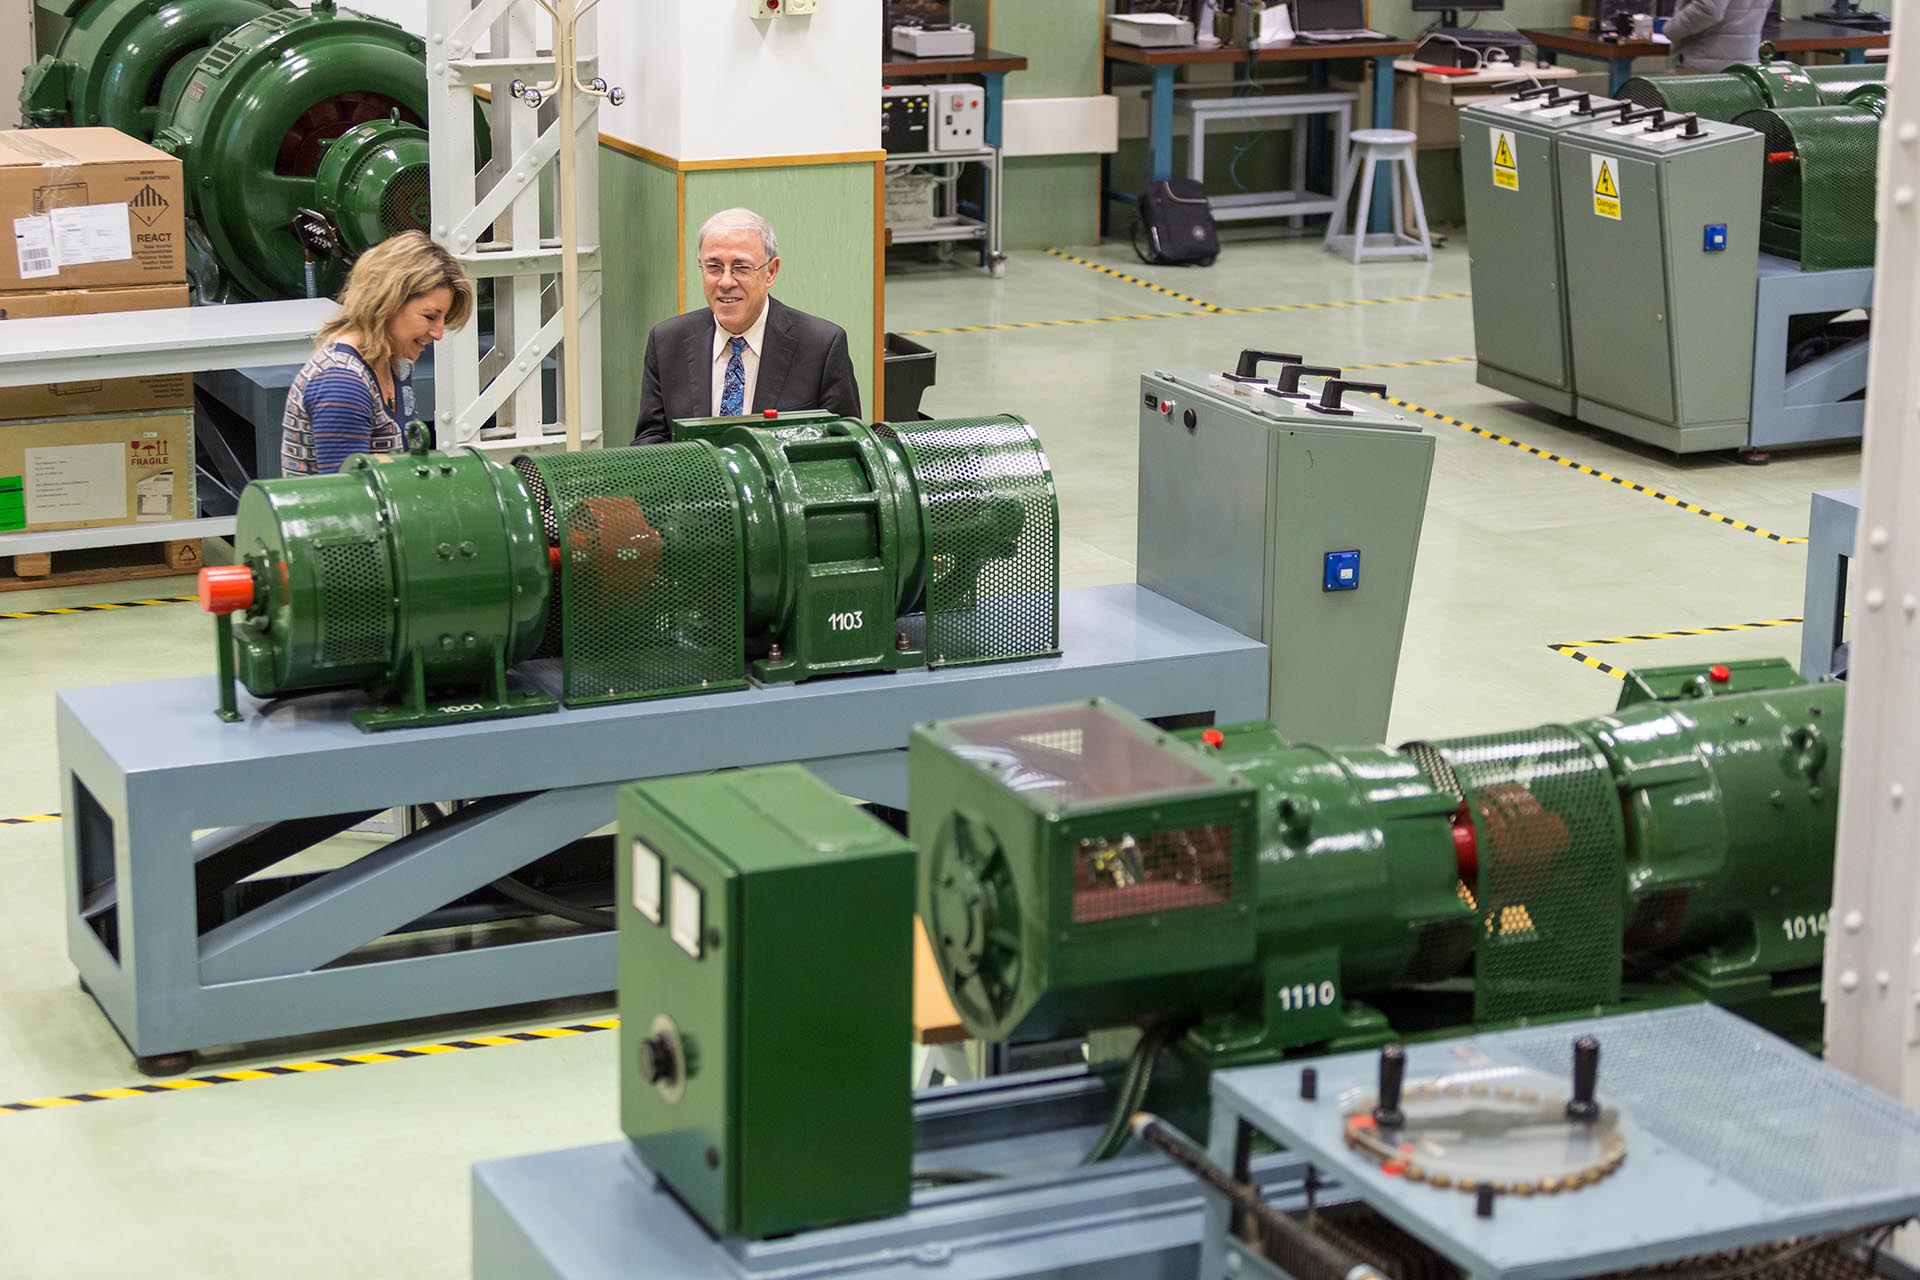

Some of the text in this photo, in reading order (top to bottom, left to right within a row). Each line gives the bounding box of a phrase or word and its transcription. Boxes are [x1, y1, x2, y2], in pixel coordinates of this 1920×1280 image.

[1596, 196, 1618, 210] Danger
[136, 232, 172, 242] REACT
[131, 456, 169, 466] FRAGILE
[828, 610, 863, 630] 1103
[438, 703, 484, 713] 1001
[1278, 980, 1335, 1011] 1110
